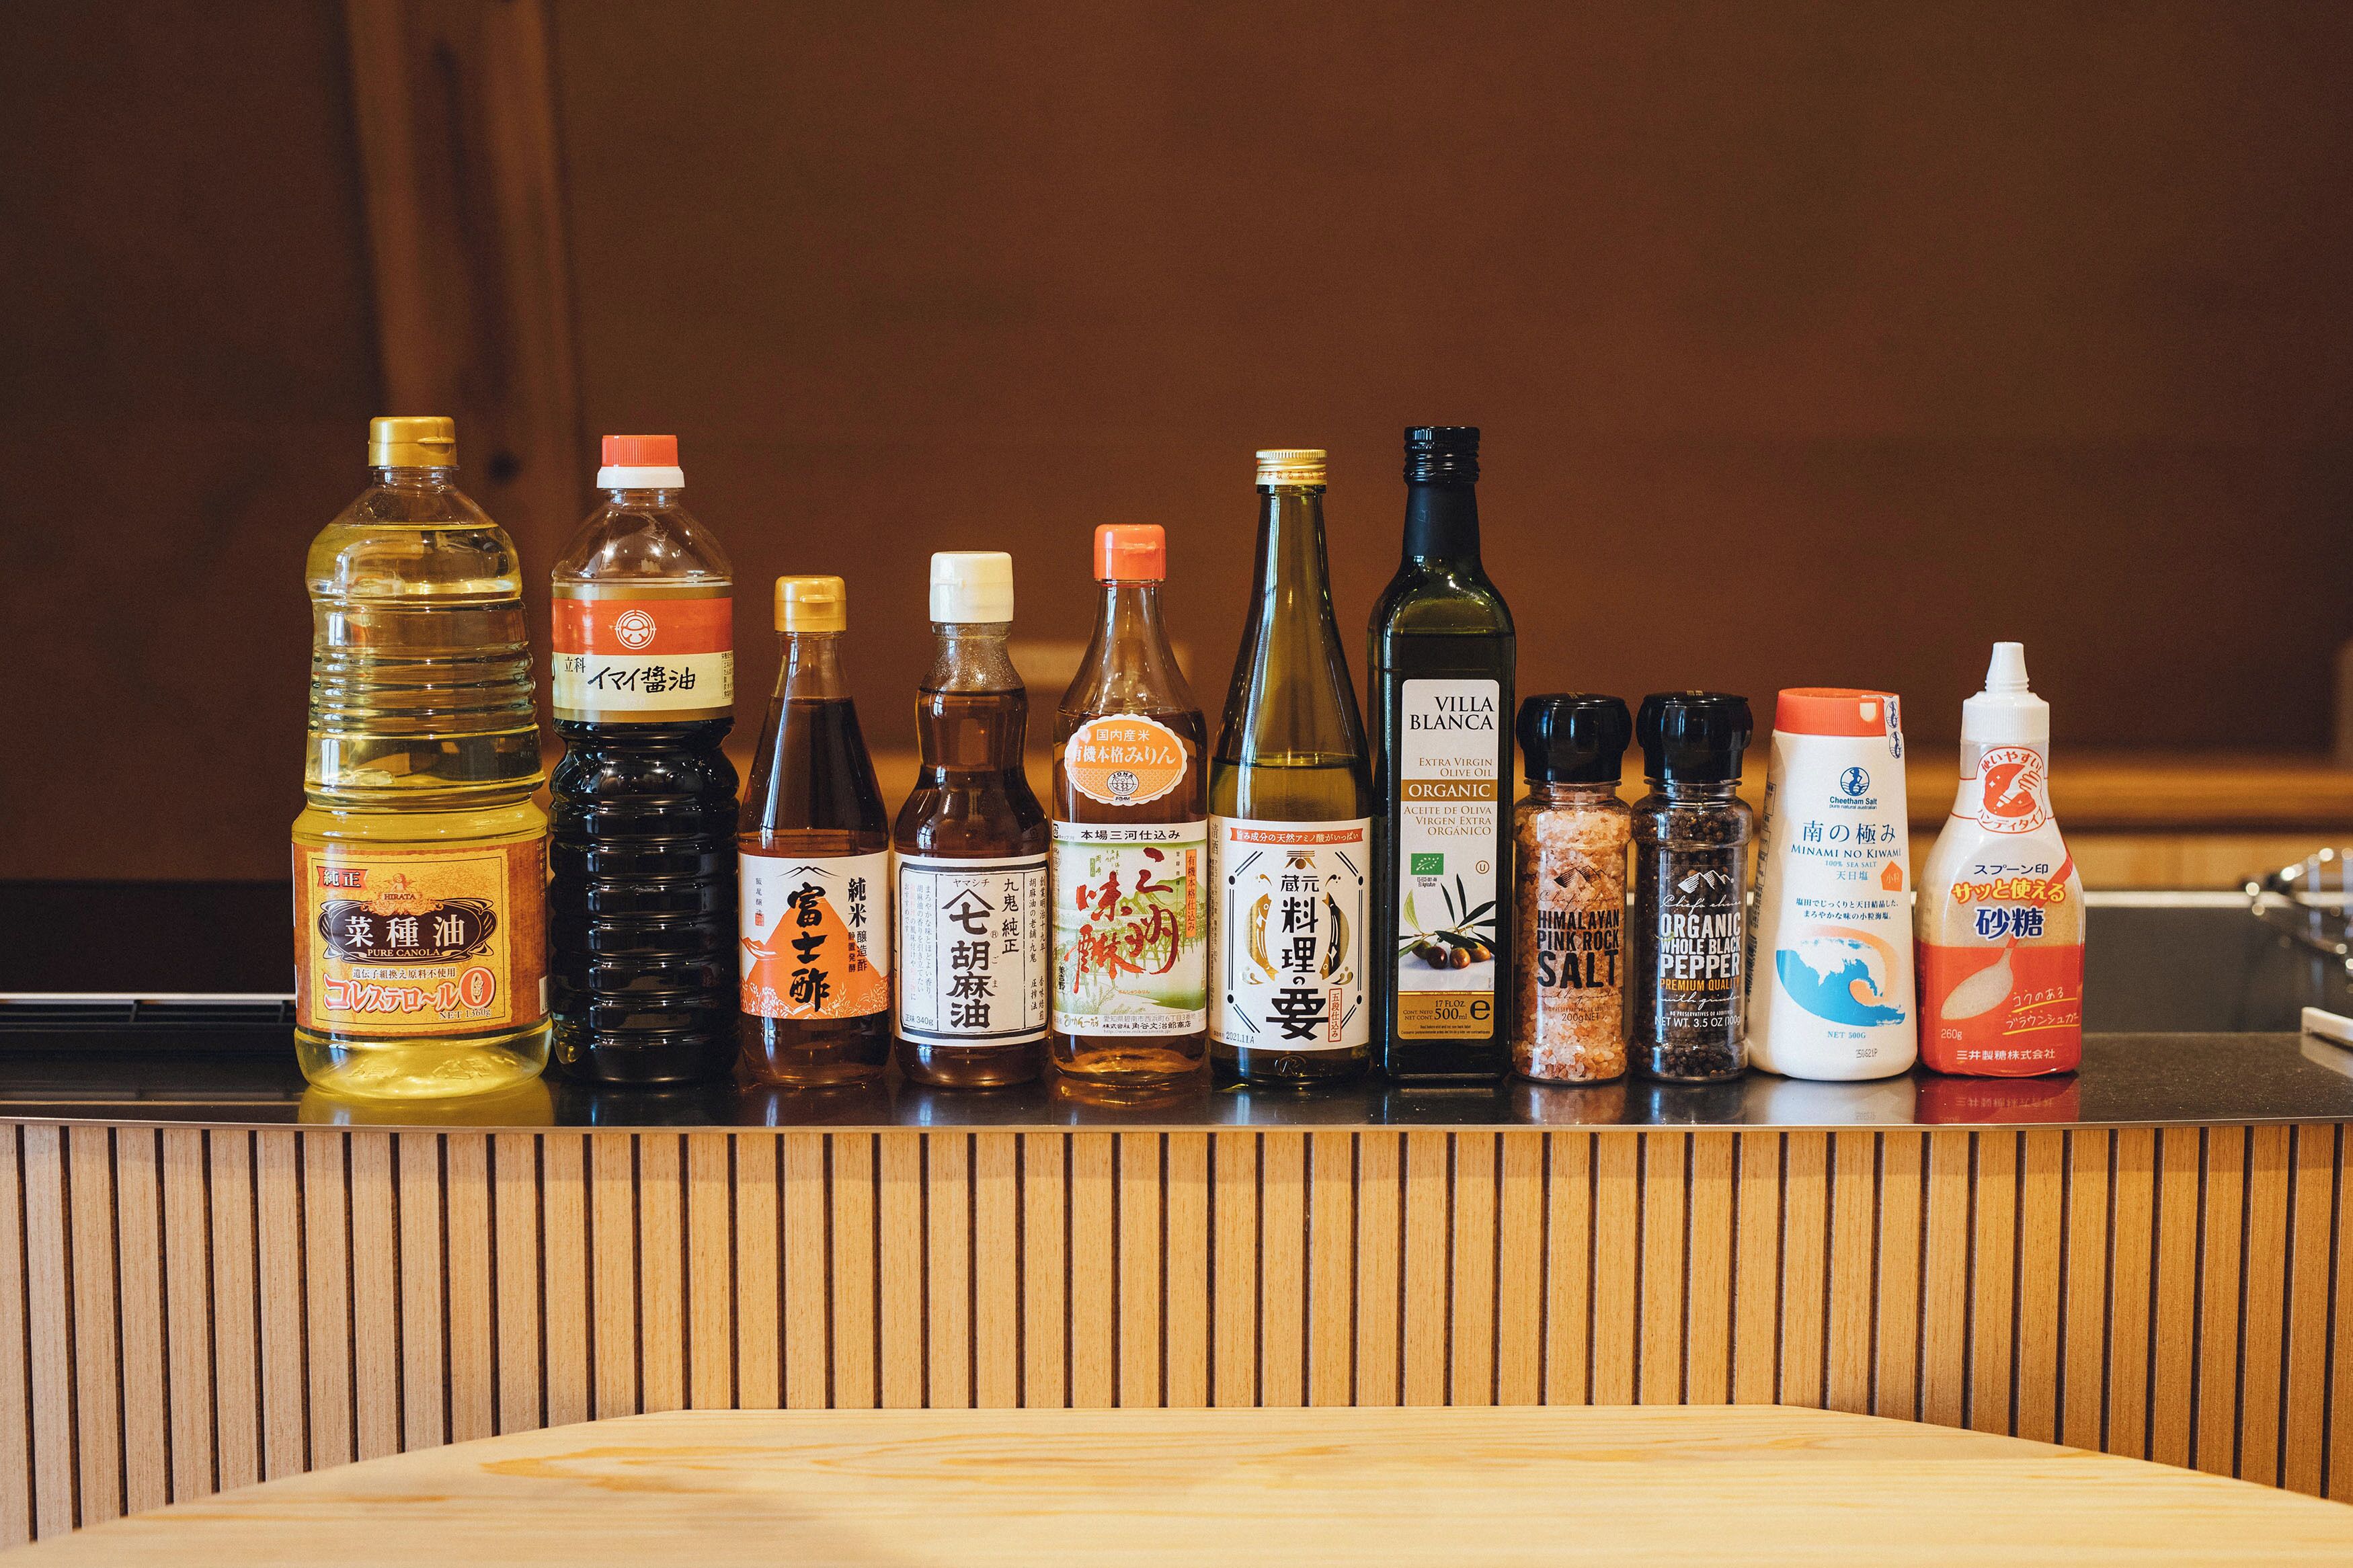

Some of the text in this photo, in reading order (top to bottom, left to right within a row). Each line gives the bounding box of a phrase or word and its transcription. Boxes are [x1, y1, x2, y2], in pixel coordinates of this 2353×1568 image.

[564, 657, 586, 673] 立科
[1434, 696, 1494, 712] VILLA
[1410, 714, 1494, 730] BLANCA
[1096, 729, 1150, 741] 国内産米
[1074, 745, 1176, 766] 有機本格みりん
[1408, 784, 1490, 797] ORGANIC
[1829, 796, 1864, 804] Cheetham
[1978, 807, 2044, 831] ハンディタイプ
[1081, 829, 1181, 841] 本場三河仕込み
[1236, 829, 1359, 843] 旨み成分の天然アミノ酸がいっぱい
[1427, 825, 1491, 835] ORGÁNICO
[1803, 820, 1895, 844] 南の極み
[1211, 823, 1219, 856] 清酒
[1837, 871, 1868, 880] 天日塩
[1974, 864, 2048, 875] スプーン印
[323, 870, 361, 887] 純正
[953, 878, 990, 888] ヤマシチ
[1281, 874, 1320, 892] 蔵元
[1886, 873, 1900, 883] 小粒
[1187, 855, 1195, 932] 有機本格仕込み
[1952, 878, 2065, 903] サッと使える
[1796, 898, 1899, 908] 塩田でじっくりと天日結晶した、
[1002, 878, 1019, 954] 九鬼 純正
[1538, 909, 1620, 930] HIMALAYAN
[1804, 910, 1891, 920] まろやかな味の小粒海塩。
[1975, 907, 2044, 939] 砂糖
[345, 915, 465, 948] 菜種油
[848, 877, 867, 972] 純米 醸造酢
[1660, 911, 1741, 938] ORGANIC
[787, 882, 830, 1012] 富士酢
[1537, 929, 1620, 951] PINK ROCK
[1661, 936, 1741, 955] WHOLE BLACK
[396, 948, 440, 956] CANOLA
[353, 968, 456, 979] 遺伝子組換え原料不使用
[1266, 897, 1328, 1042] 料理の要
[1538, 949, 1618, 989] SALT
[1660, 952, 1741, 979] PEPPER
[1660, 976, 1741, 991] PREMIUM QUALITY
[1660, 991, 1740, 1011] with grinder
[2013, 987, 2064, 1007] コクのある
[440, 1009, 491, 1019] NET 1360g
[905, 1014, 933, 1026] 正味 340g
[1331, 993, 1340, 1038] 五段仕込み
[1562, 1012, 1599, 1023] 200g NET
[1655, 1016, 1671, 1026] NET
[1674, 1017, 1690, 1027] WT.
[1693, 1018, 1708, 1027] 3.5
[1711, 1018, 1722, 1027] OZ
[2006, 1012, 2079, 1029] ブラウンシュガー
[1131, 1020, 1192, 1030] 角谷文治郎商店
[1941, 1029, 1962, 1040] 260g
[1956, 1049, 2055, 1061] 三井製糖株式会社
